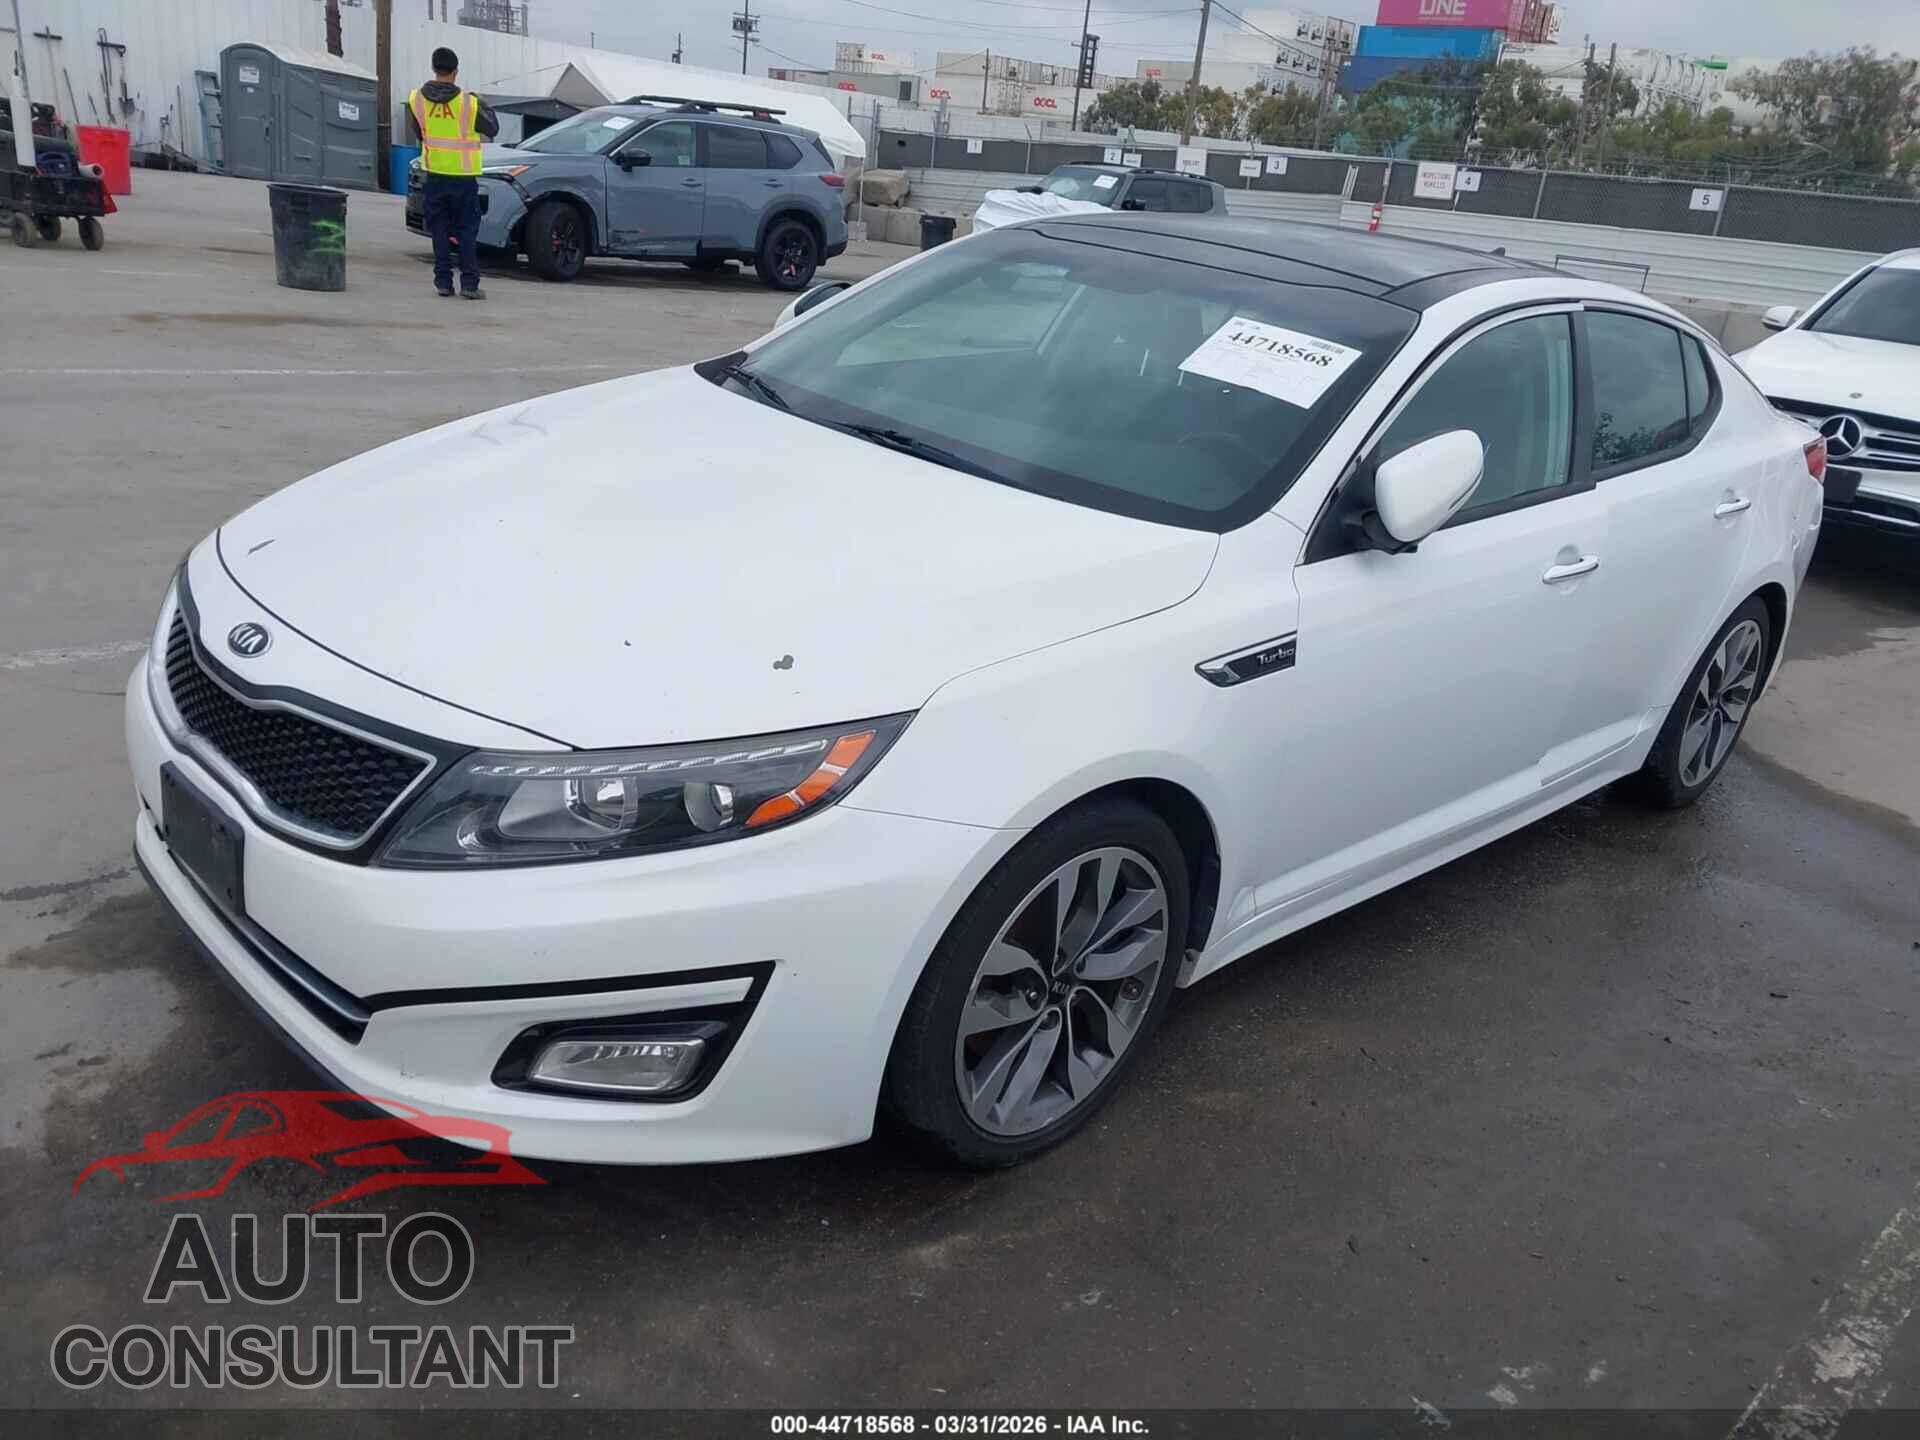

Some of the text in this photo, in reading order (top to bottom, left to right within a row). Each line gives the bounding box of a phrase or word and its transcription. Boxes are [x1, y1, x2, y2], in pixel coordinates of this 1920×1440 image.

[1033, 97, 1058, 109] OOCL
[1109, 152, 1116, 161] 2
[1273, 160, 1280, 170] 3
[1464, 176, 1472, 186] 4
[1702, 194, 1712, 205] 5
[1228, 331, 1333, 367] 44718568
[1257, 648, 1294, 664] Turbo
